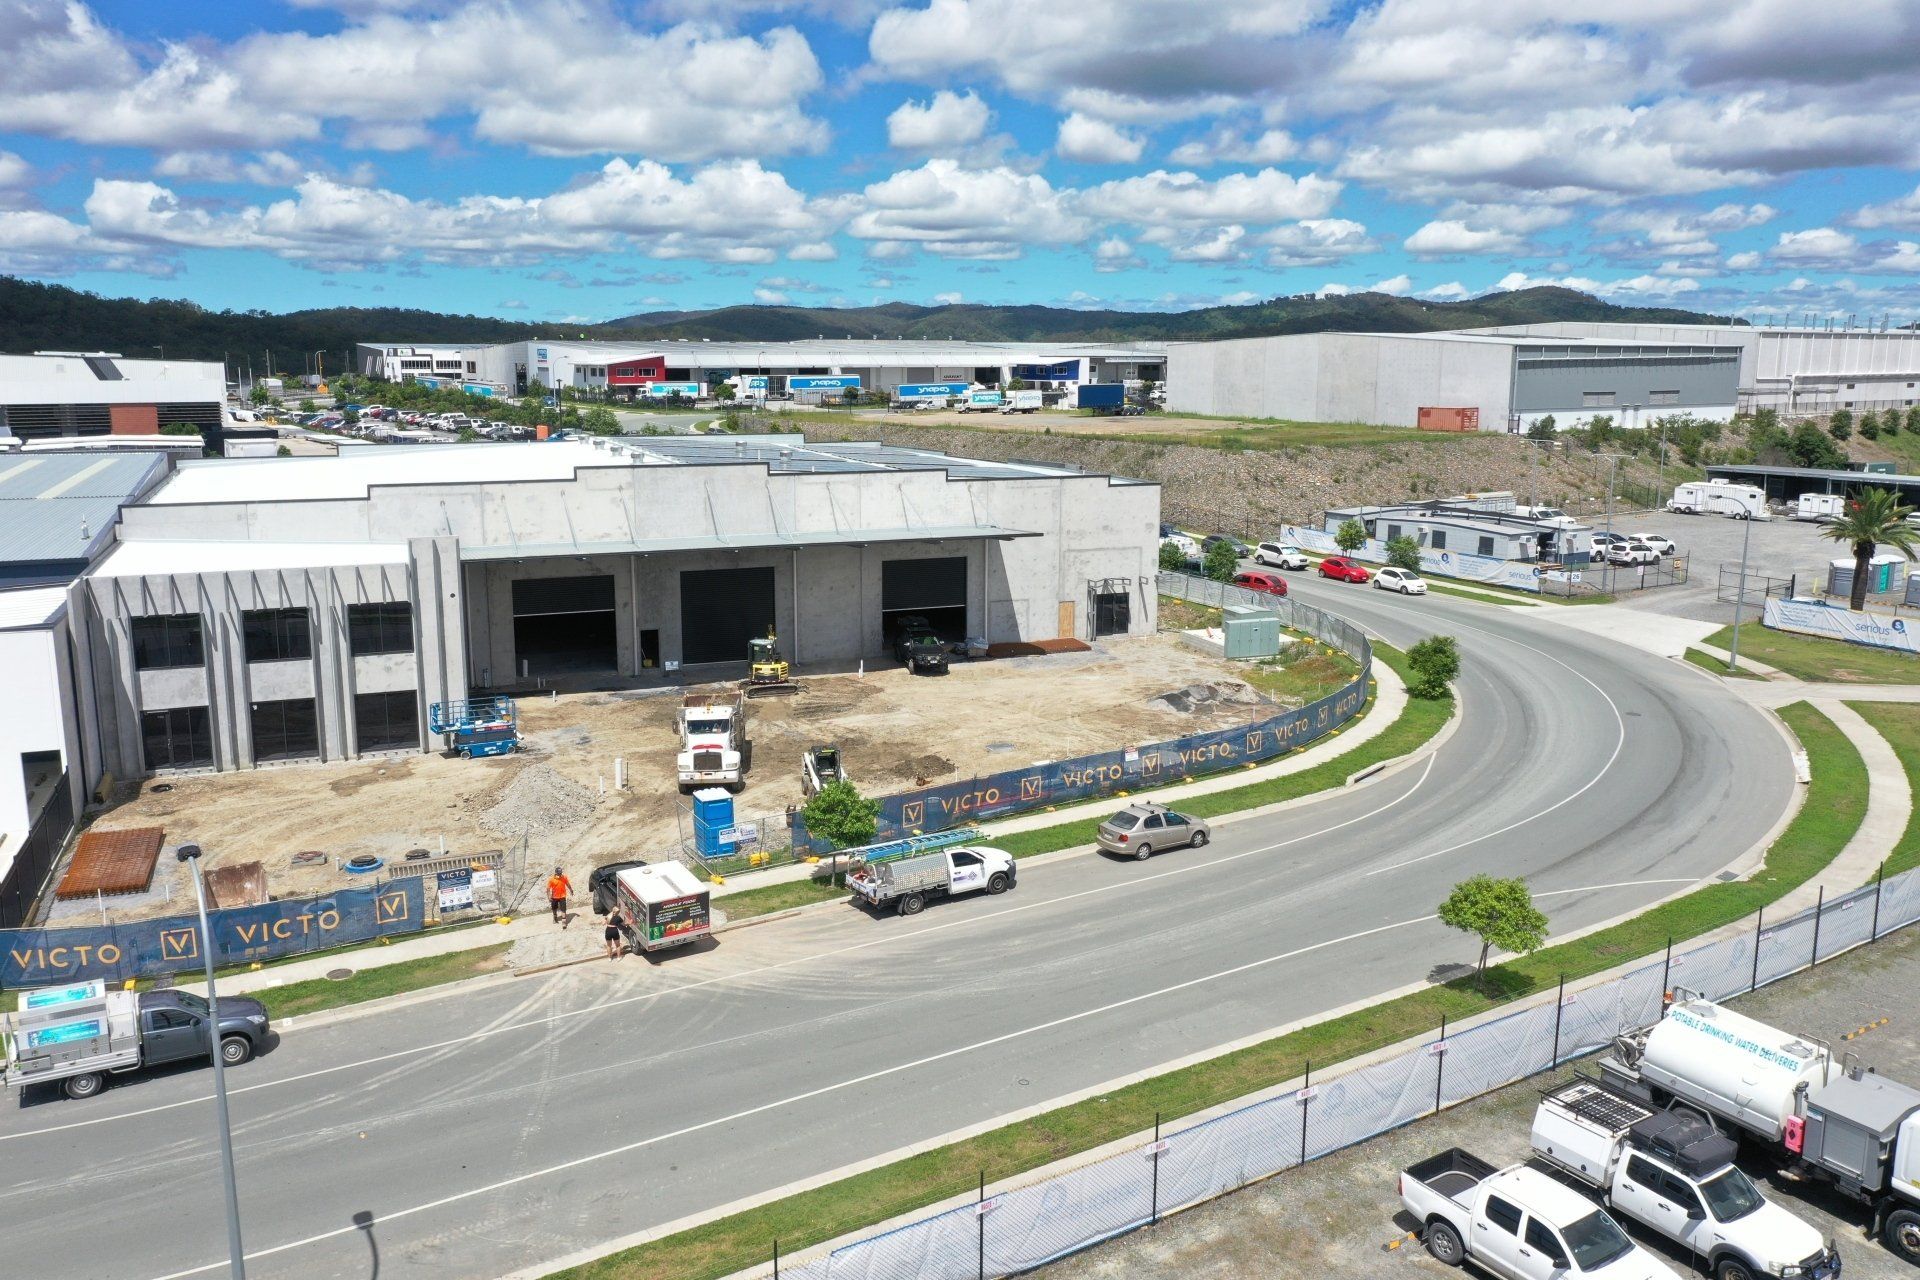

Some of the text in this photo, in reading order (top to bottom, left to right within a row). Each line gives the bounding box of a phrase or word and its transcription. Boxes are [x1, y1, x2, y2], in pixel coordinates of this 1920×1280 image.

[1855, 622, 1891, 636] serious
[1275, 718, 1308, 741] VICTO
[1179, 742, 1230, 765] VICTO
[1062, 765, 1122, 788] VICTO
[940, 787, 999, 814] VICTO
[441, 870, 466, 879] VICTO
[235, 910, 341, 944] VICTO
[11, 944, 121, 969] VICTO
[1671, 1010, 1799, 1072] POTABLE DRINKING WATER DELIVERIES
